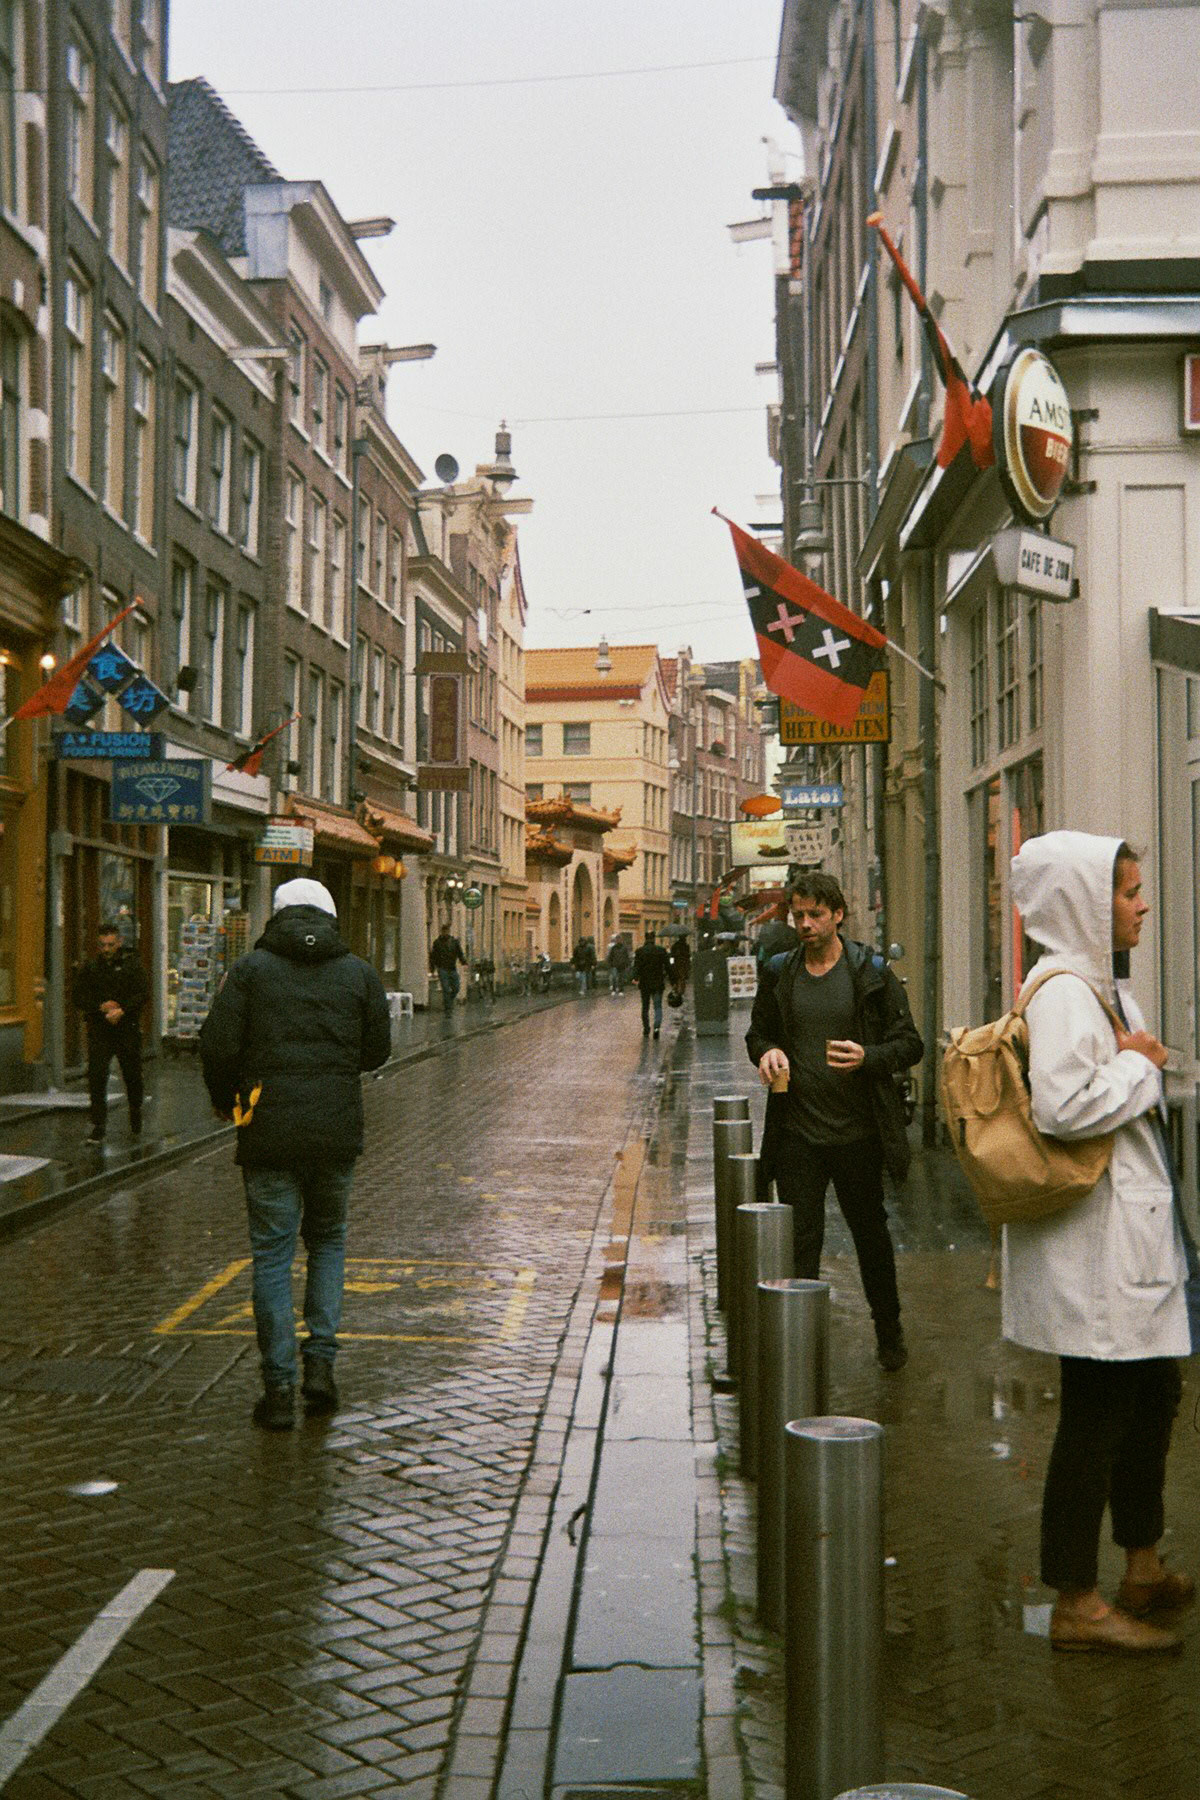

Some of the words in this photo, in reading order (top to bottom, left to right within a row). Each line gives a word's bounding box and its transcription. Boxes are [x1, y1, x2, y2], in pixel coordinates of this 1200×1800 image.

[1043, 555, 1054, 577] DE
[785, 721, 817, 739] HET
[821, 719, 884, 738] OOTEN
[90, 733, 151, 747] FUSION
[263, 848, 293, 861] ATM
